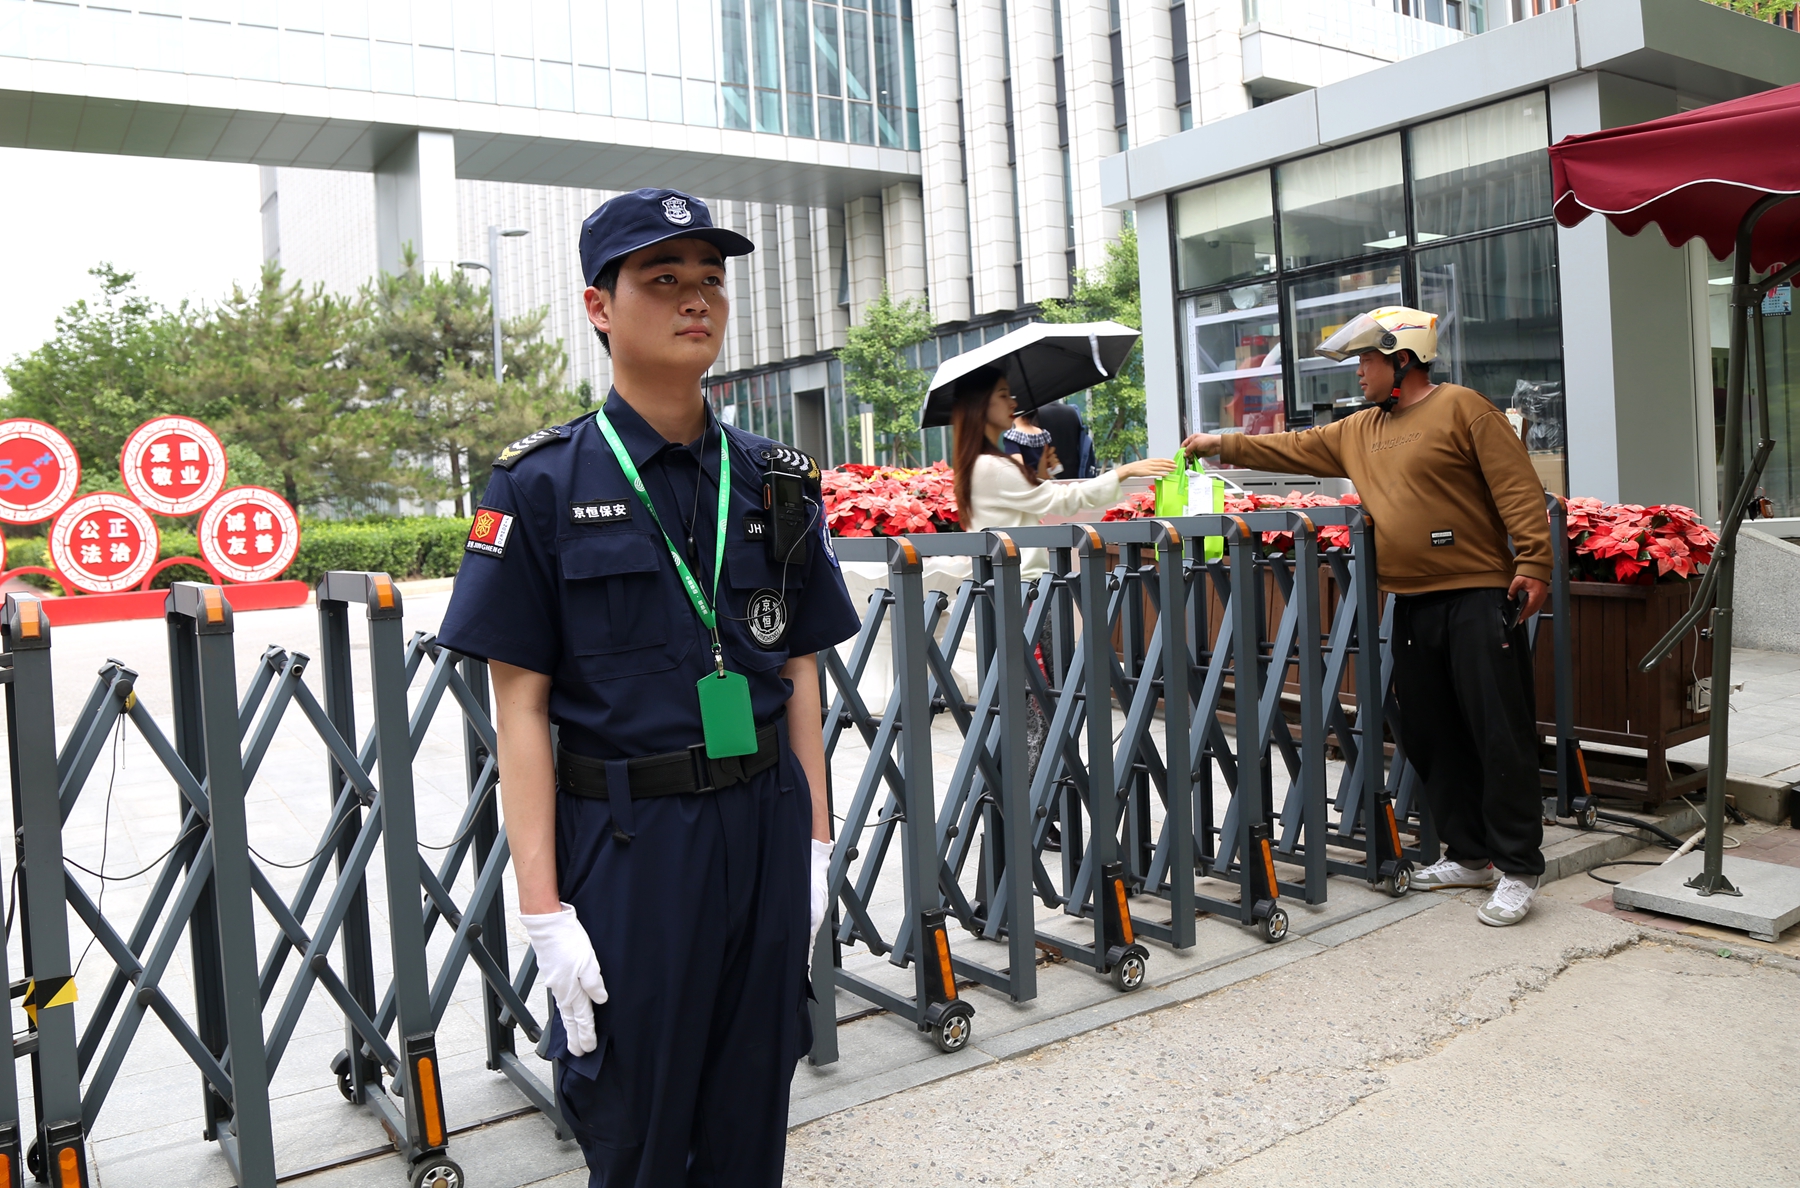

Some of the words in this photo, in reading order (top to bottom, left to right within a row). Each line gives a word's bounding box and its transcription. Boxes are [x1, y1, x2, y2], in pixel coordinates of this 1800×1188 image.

[150, 442, 200, 463] 爱国
[151, 465, 200, 486] 敬业
[225, 511, 273, 532] 诚信
[572, 503, 627, 519] 京恒保安
[79, 518, 129, 540] 公正
[80, 542, 131, 564] 法治
[227, 534, 275, 556] 友善
[762, 599, 772, 628] 京恒
